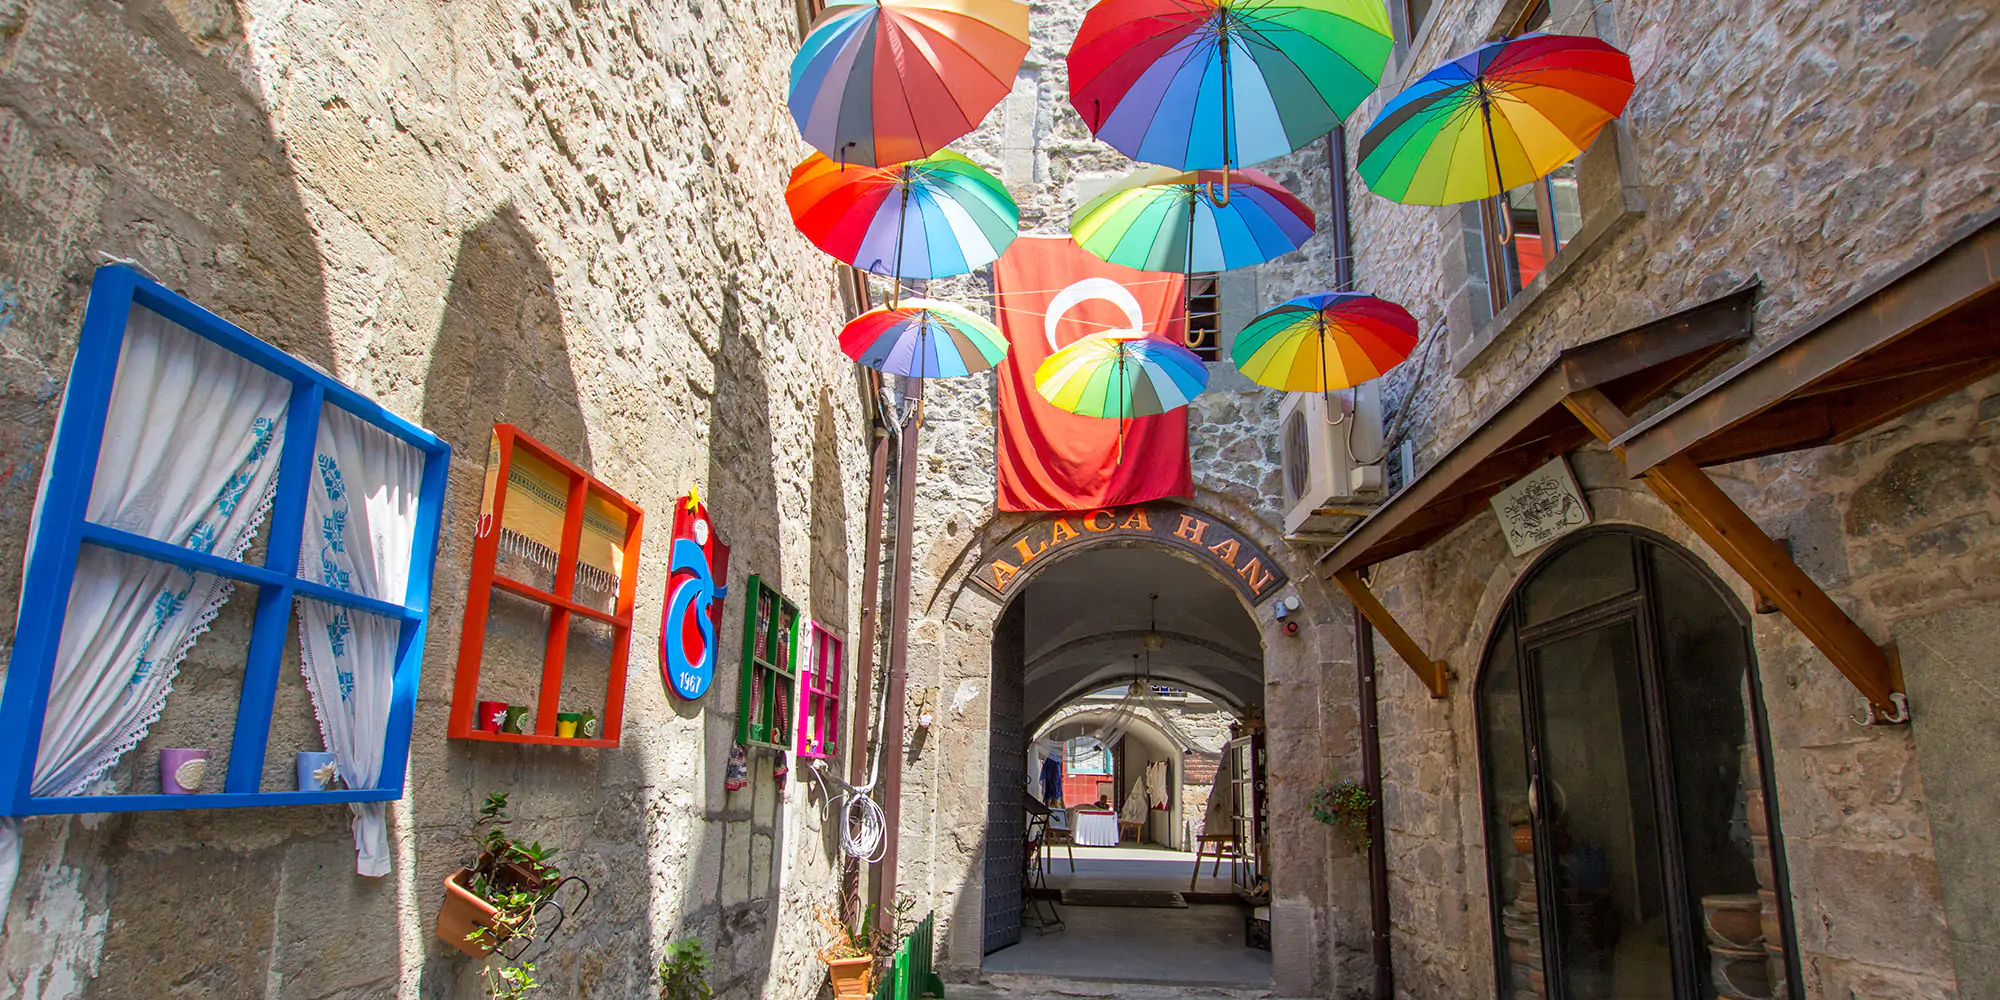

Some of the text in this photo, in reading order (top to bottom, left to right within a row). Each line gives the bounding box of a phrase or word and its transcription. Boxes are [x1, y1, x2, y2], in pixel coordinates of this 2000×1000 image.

[991, 507, 1275, 595] ALACA HAN
[680, 671, 701, 693] 1967
